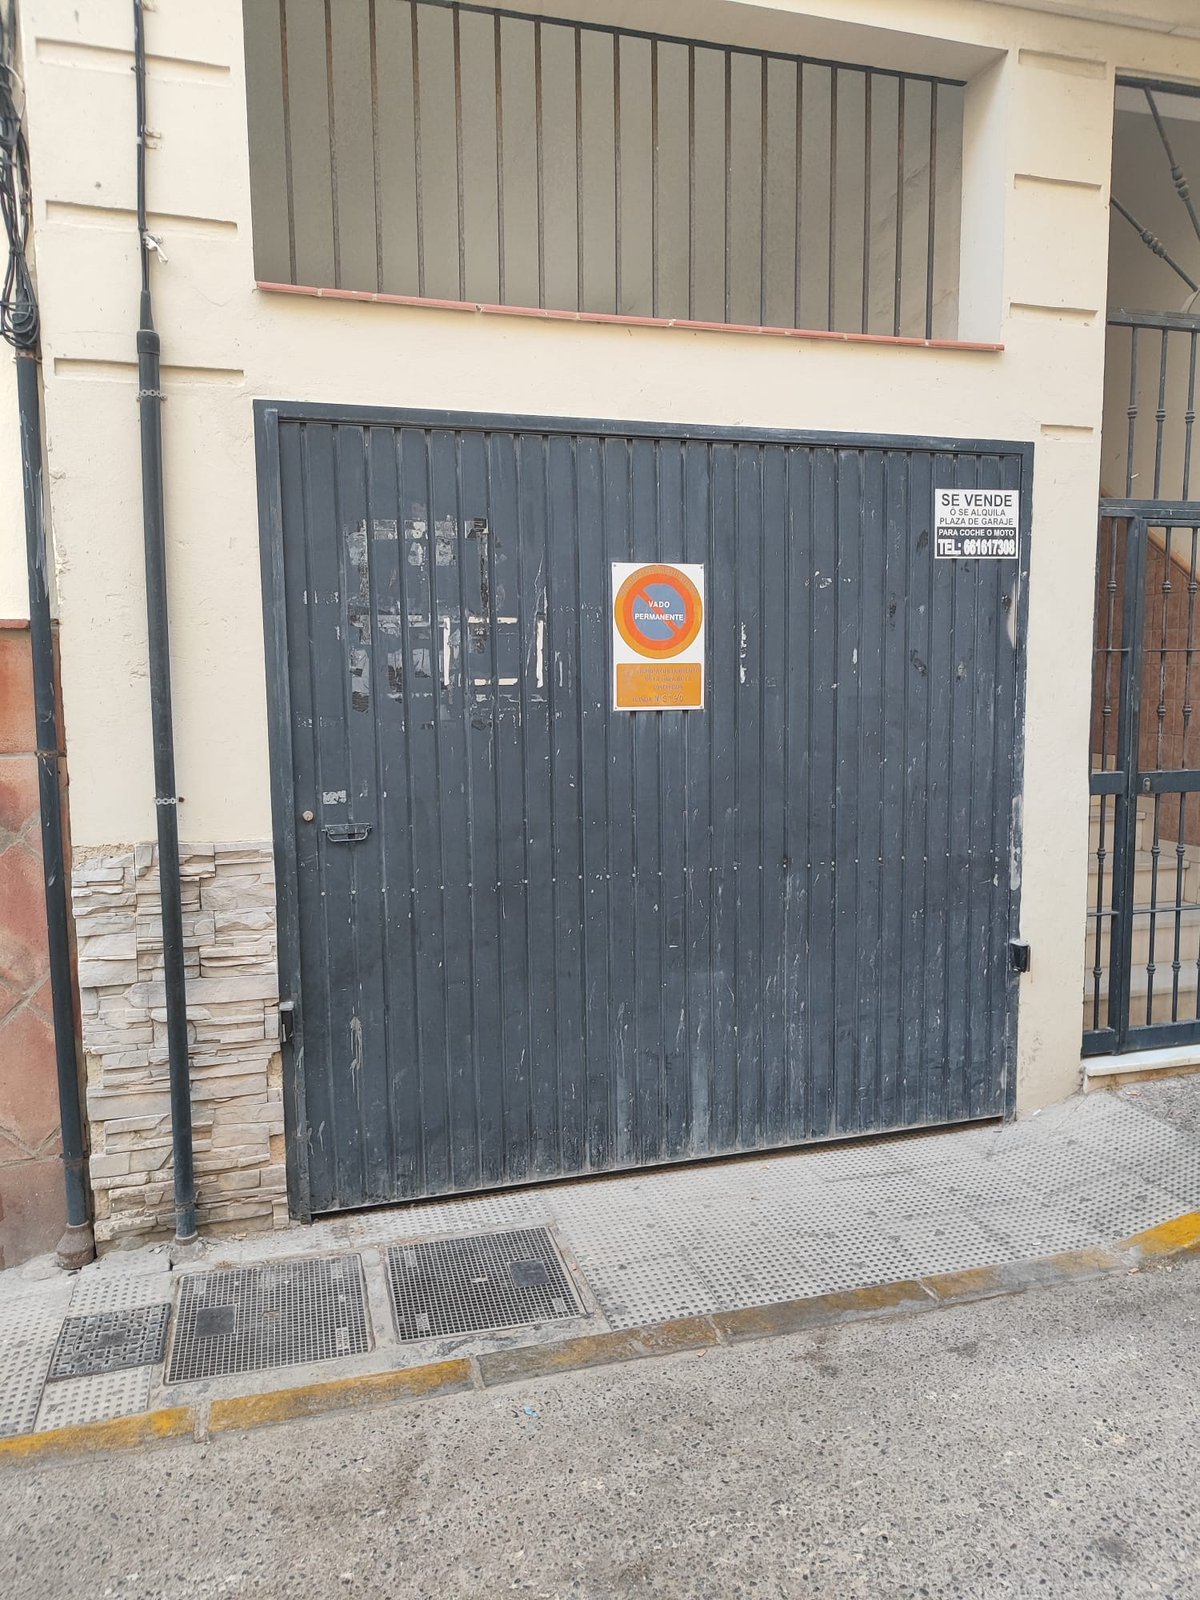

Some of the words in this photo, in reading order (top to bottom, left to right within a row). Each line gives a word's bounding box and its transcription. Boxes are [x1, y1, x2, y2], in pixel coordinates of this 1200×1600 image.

[941, 493, 960, 507] SE
[964, 494, 1013, 507] VENDE
[958, 508, 969, 516] SE
[970, 508, 1006, 517] ALQUILA
[939, 517, 966, 526] PLAZA
[967, 517, 979, 526] DE
[981, 517, 1014, 526] GARAJE
[938, 528, 959, 536] PARA
[959, 529, 985, 537] COCHE
[993, 529, 1015, 537] MOTO
[648, 600, 671, 609] VADO
[634, 612, 684, 622] PERMANENTE
